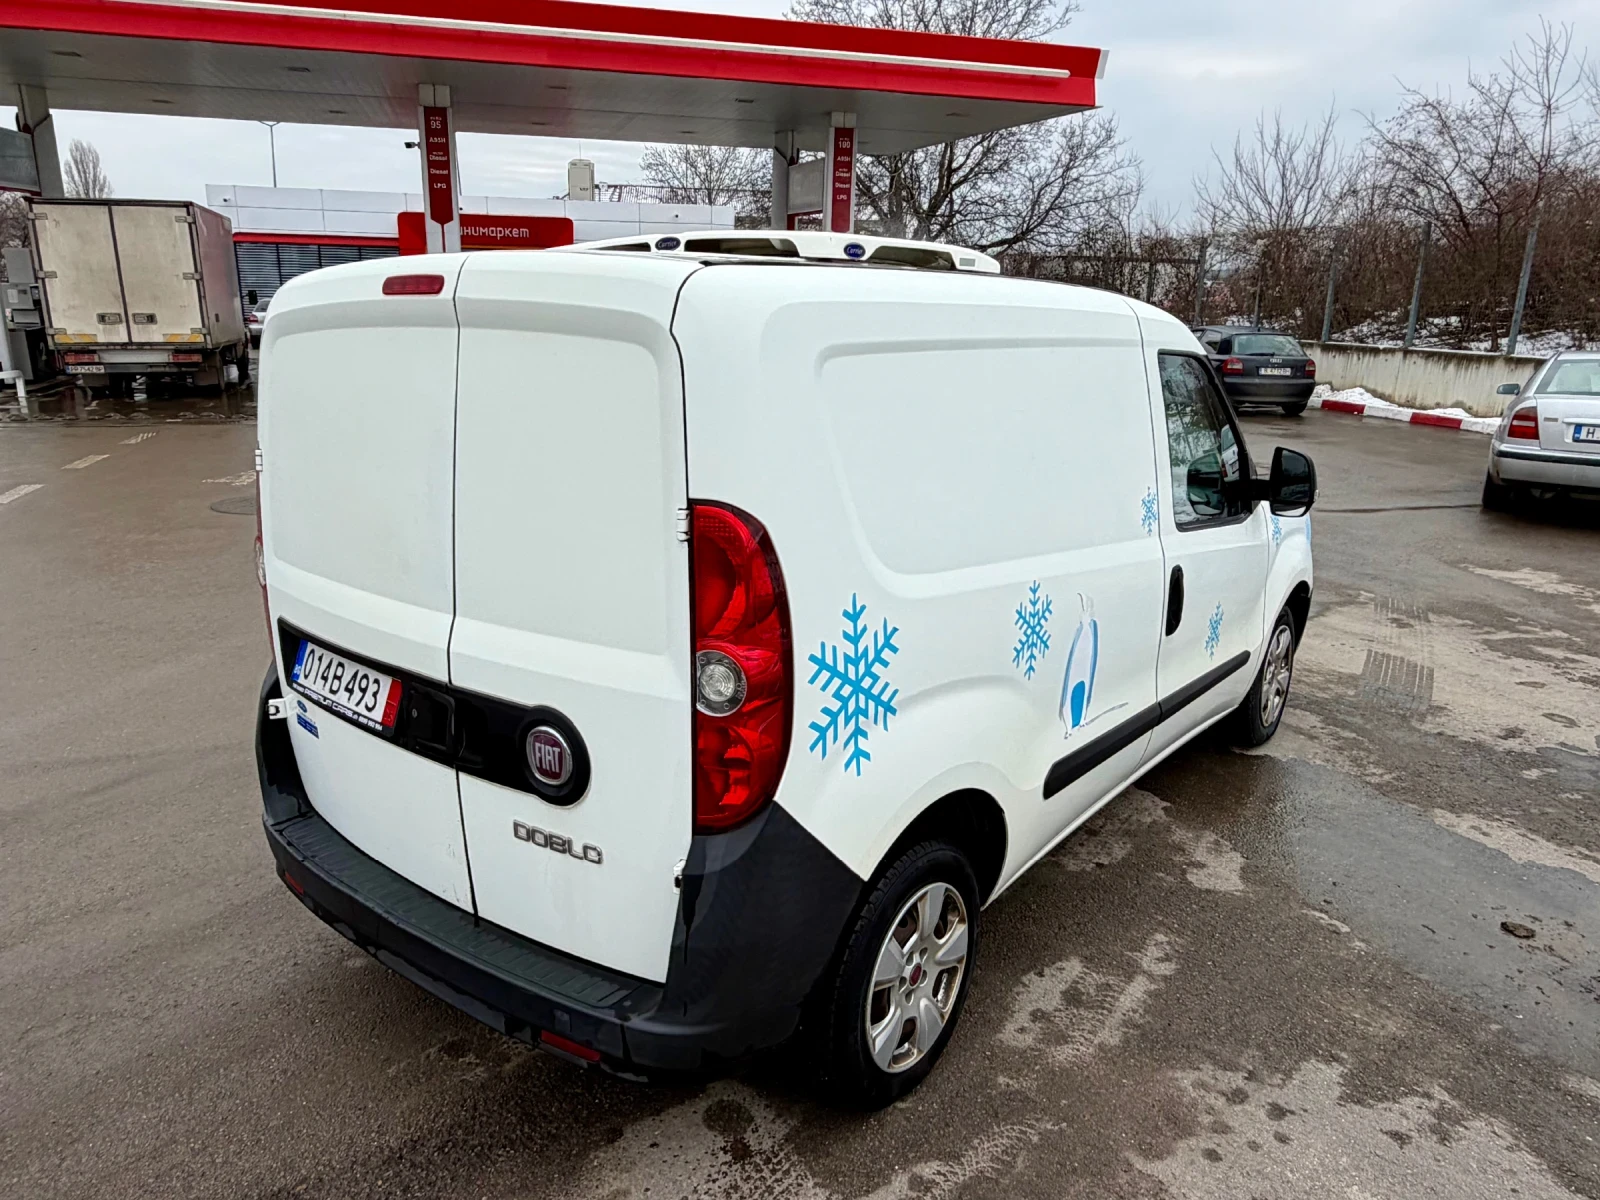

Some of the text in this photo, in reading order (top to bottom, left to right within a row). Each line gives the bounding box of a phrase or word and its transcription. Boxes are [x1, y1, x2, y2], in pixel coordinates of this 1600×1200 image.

[430, 120, 442, 129] 95
[838, 140, 850, 148] 100
[534, 741, 561, 773] FIAT
[513, 819, 604, 865] DOBLO
